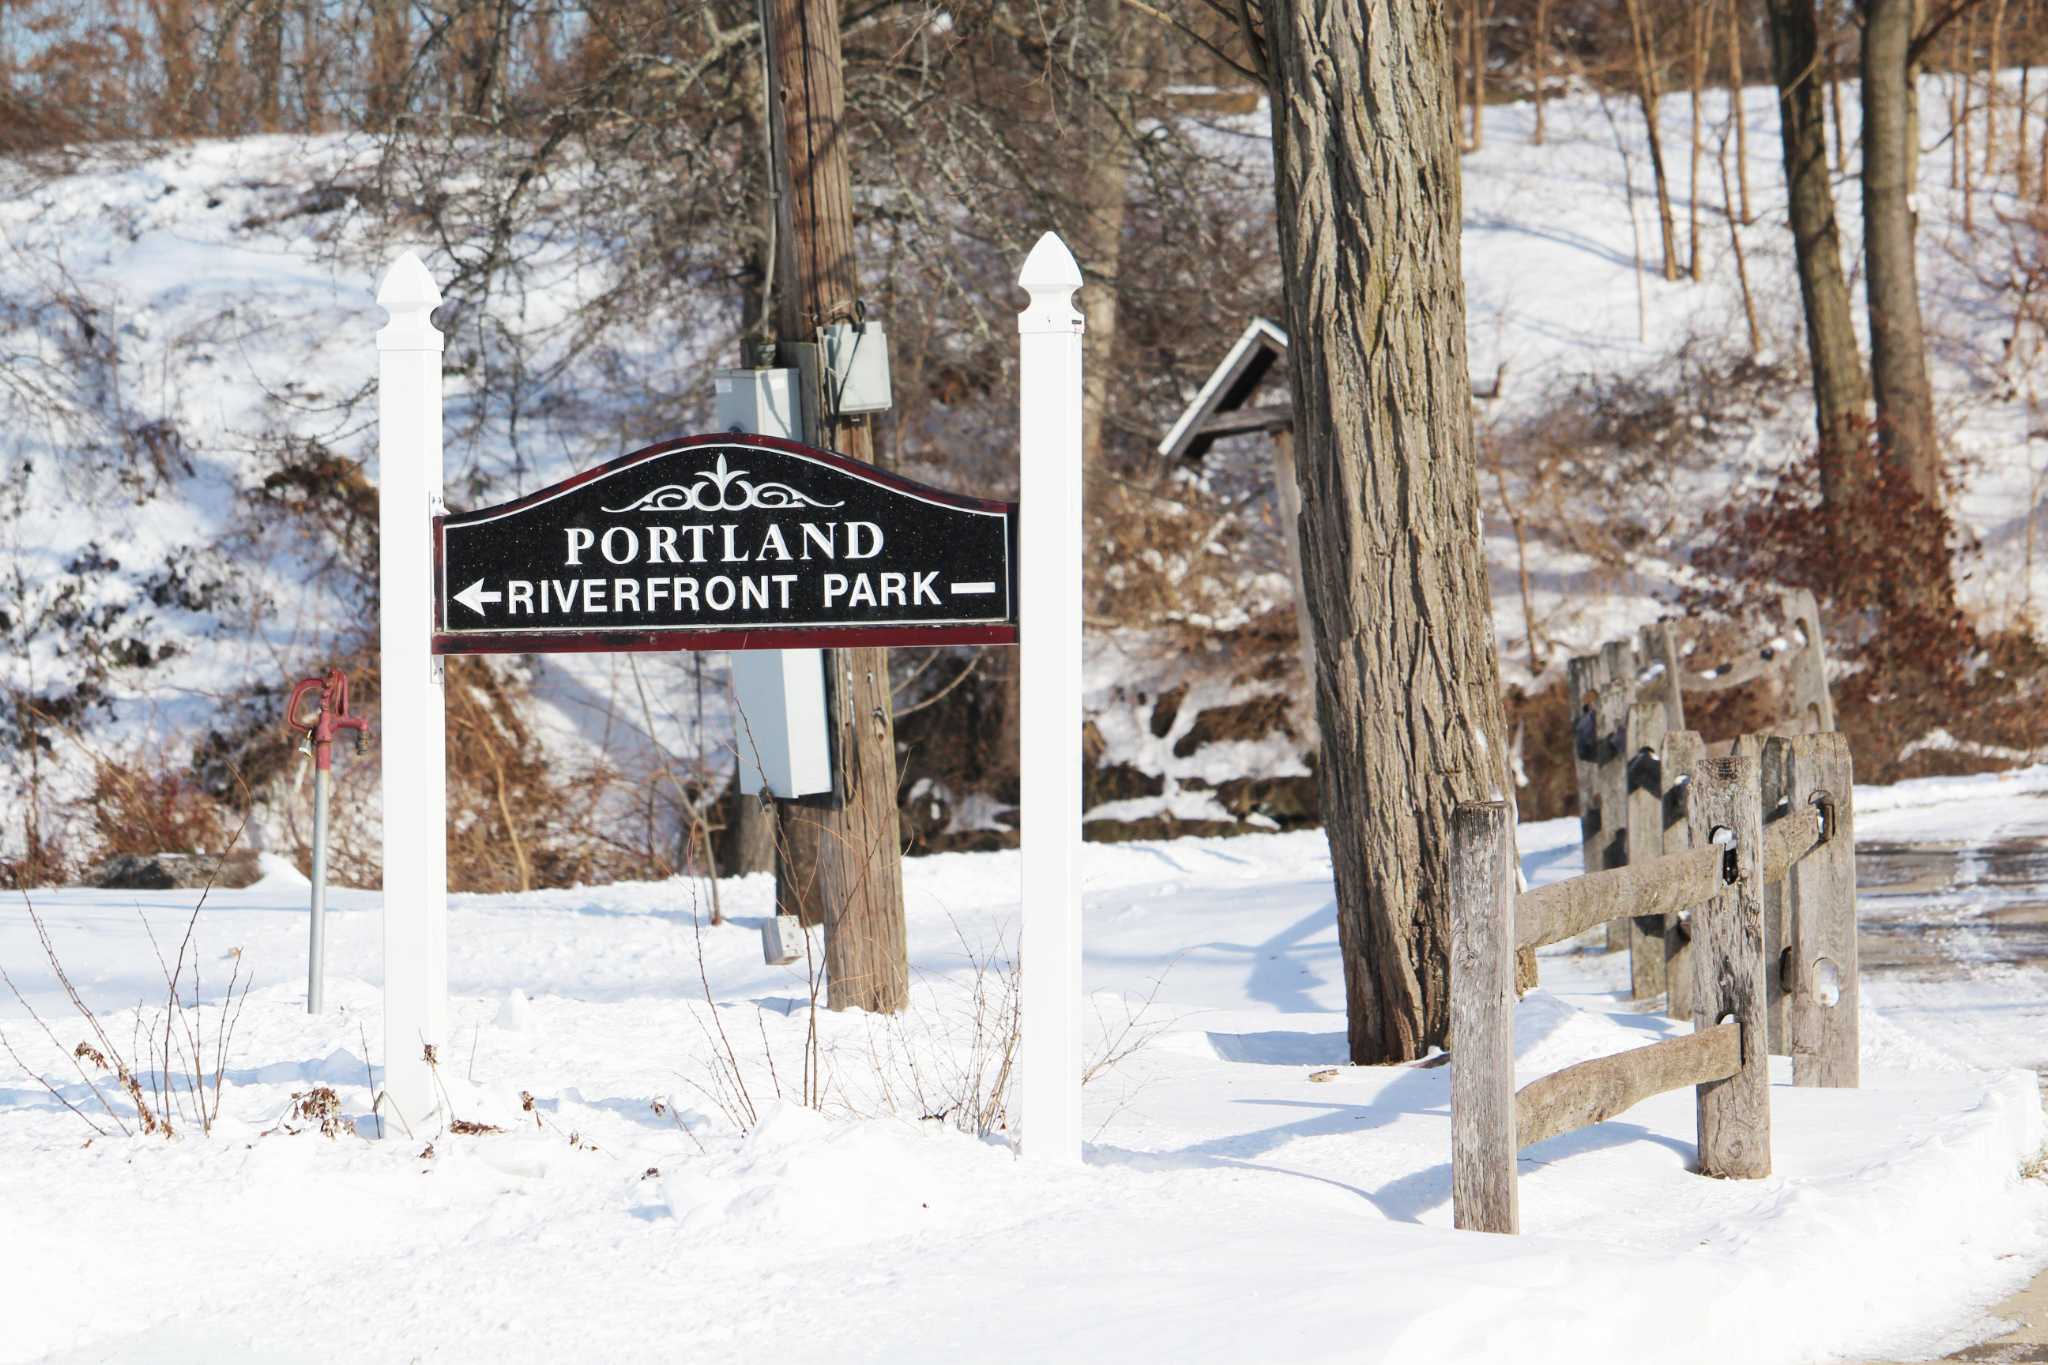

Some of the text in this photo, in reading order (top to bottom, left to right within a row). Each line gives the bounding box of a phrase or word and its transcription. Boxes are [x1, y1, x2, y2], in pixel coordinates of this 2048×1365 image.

[564, 521, 884, 566] PORTLAND
[508, 571, 942, 614] RIVERFRONT PARK
